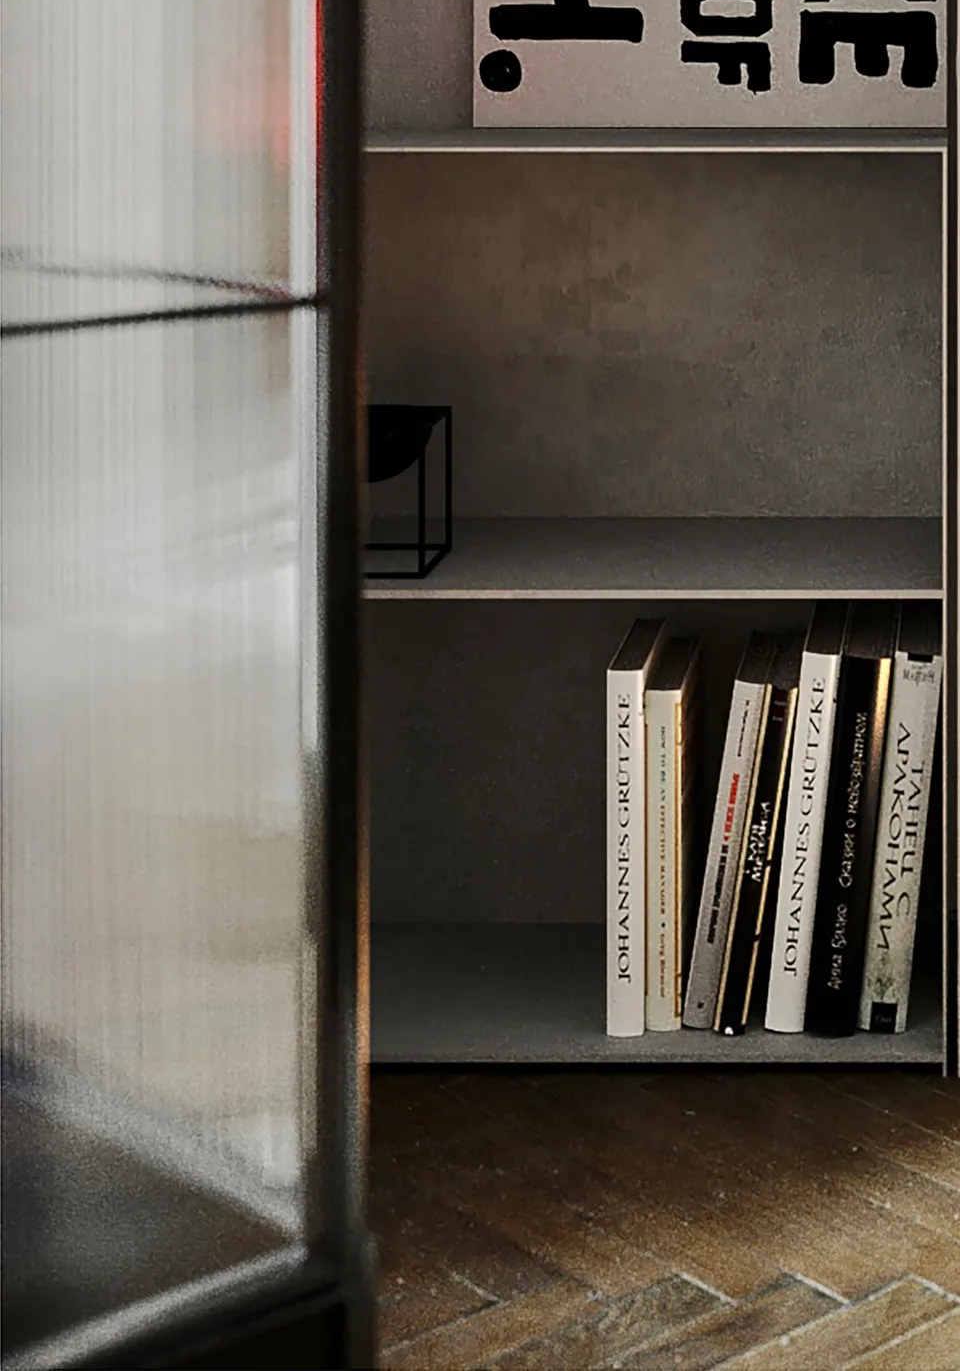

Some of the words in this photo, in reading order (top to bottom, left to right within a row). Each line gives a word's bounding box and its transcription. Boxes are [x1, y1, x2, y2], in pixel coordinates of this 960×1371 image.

[616, 693, 631, 829] GRÜTZKE
[783, 822, 810, 977] JOHANNES
[801, 677, 826, 817] GRÜTZKE
[901, 760, 925, 877] ТАНЕЦ
[617, 833, 631, 983] JOHANNES
